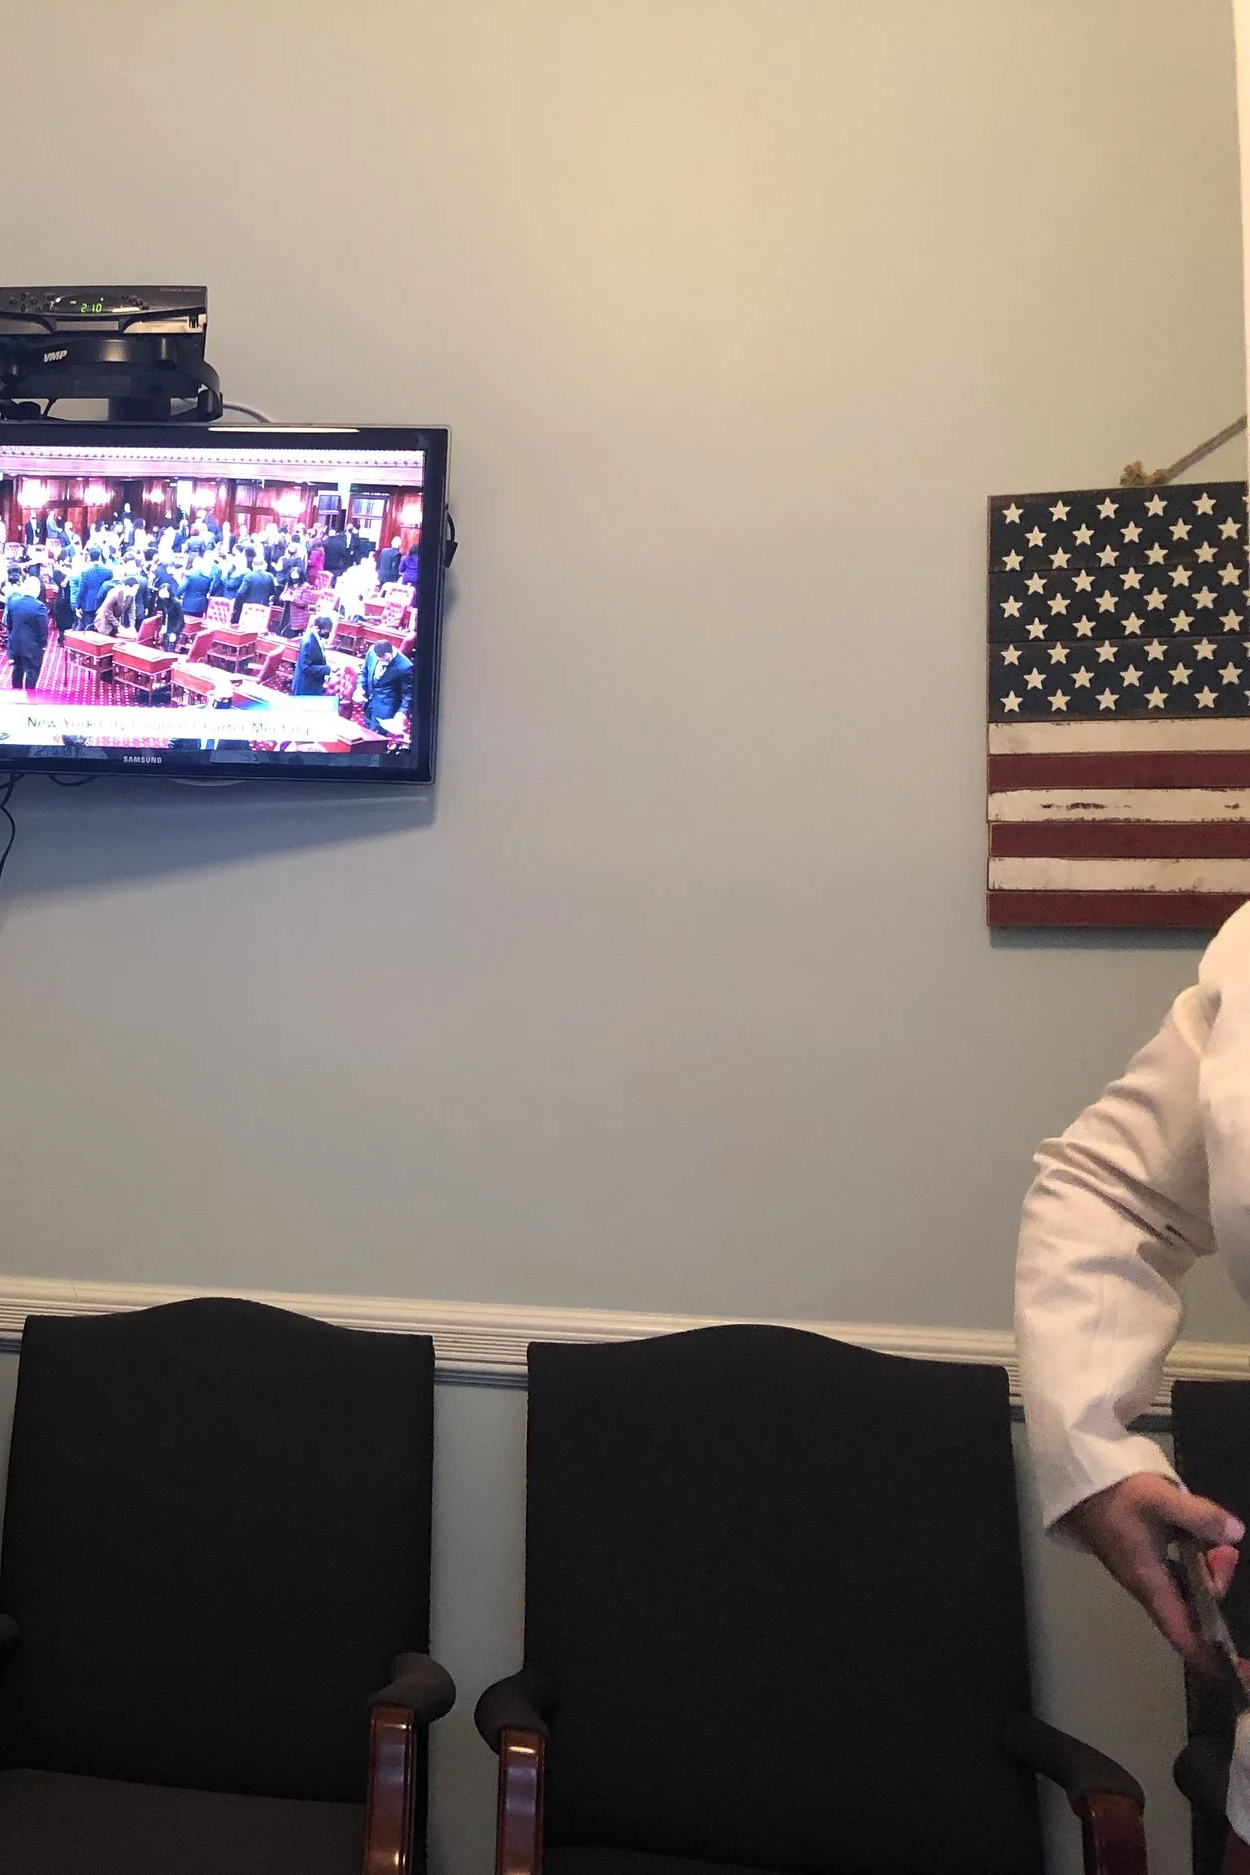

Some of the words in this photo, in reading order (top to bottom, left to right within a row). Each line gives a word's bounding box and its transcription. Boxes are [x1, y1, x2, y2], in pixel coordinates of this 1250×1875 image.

[80, 303, 103, 313] 2:10
[44, 349, 68, 362] VMP
[27, 716, 57, 729] New
[123, 755, 162, 764] SAMSUNG
